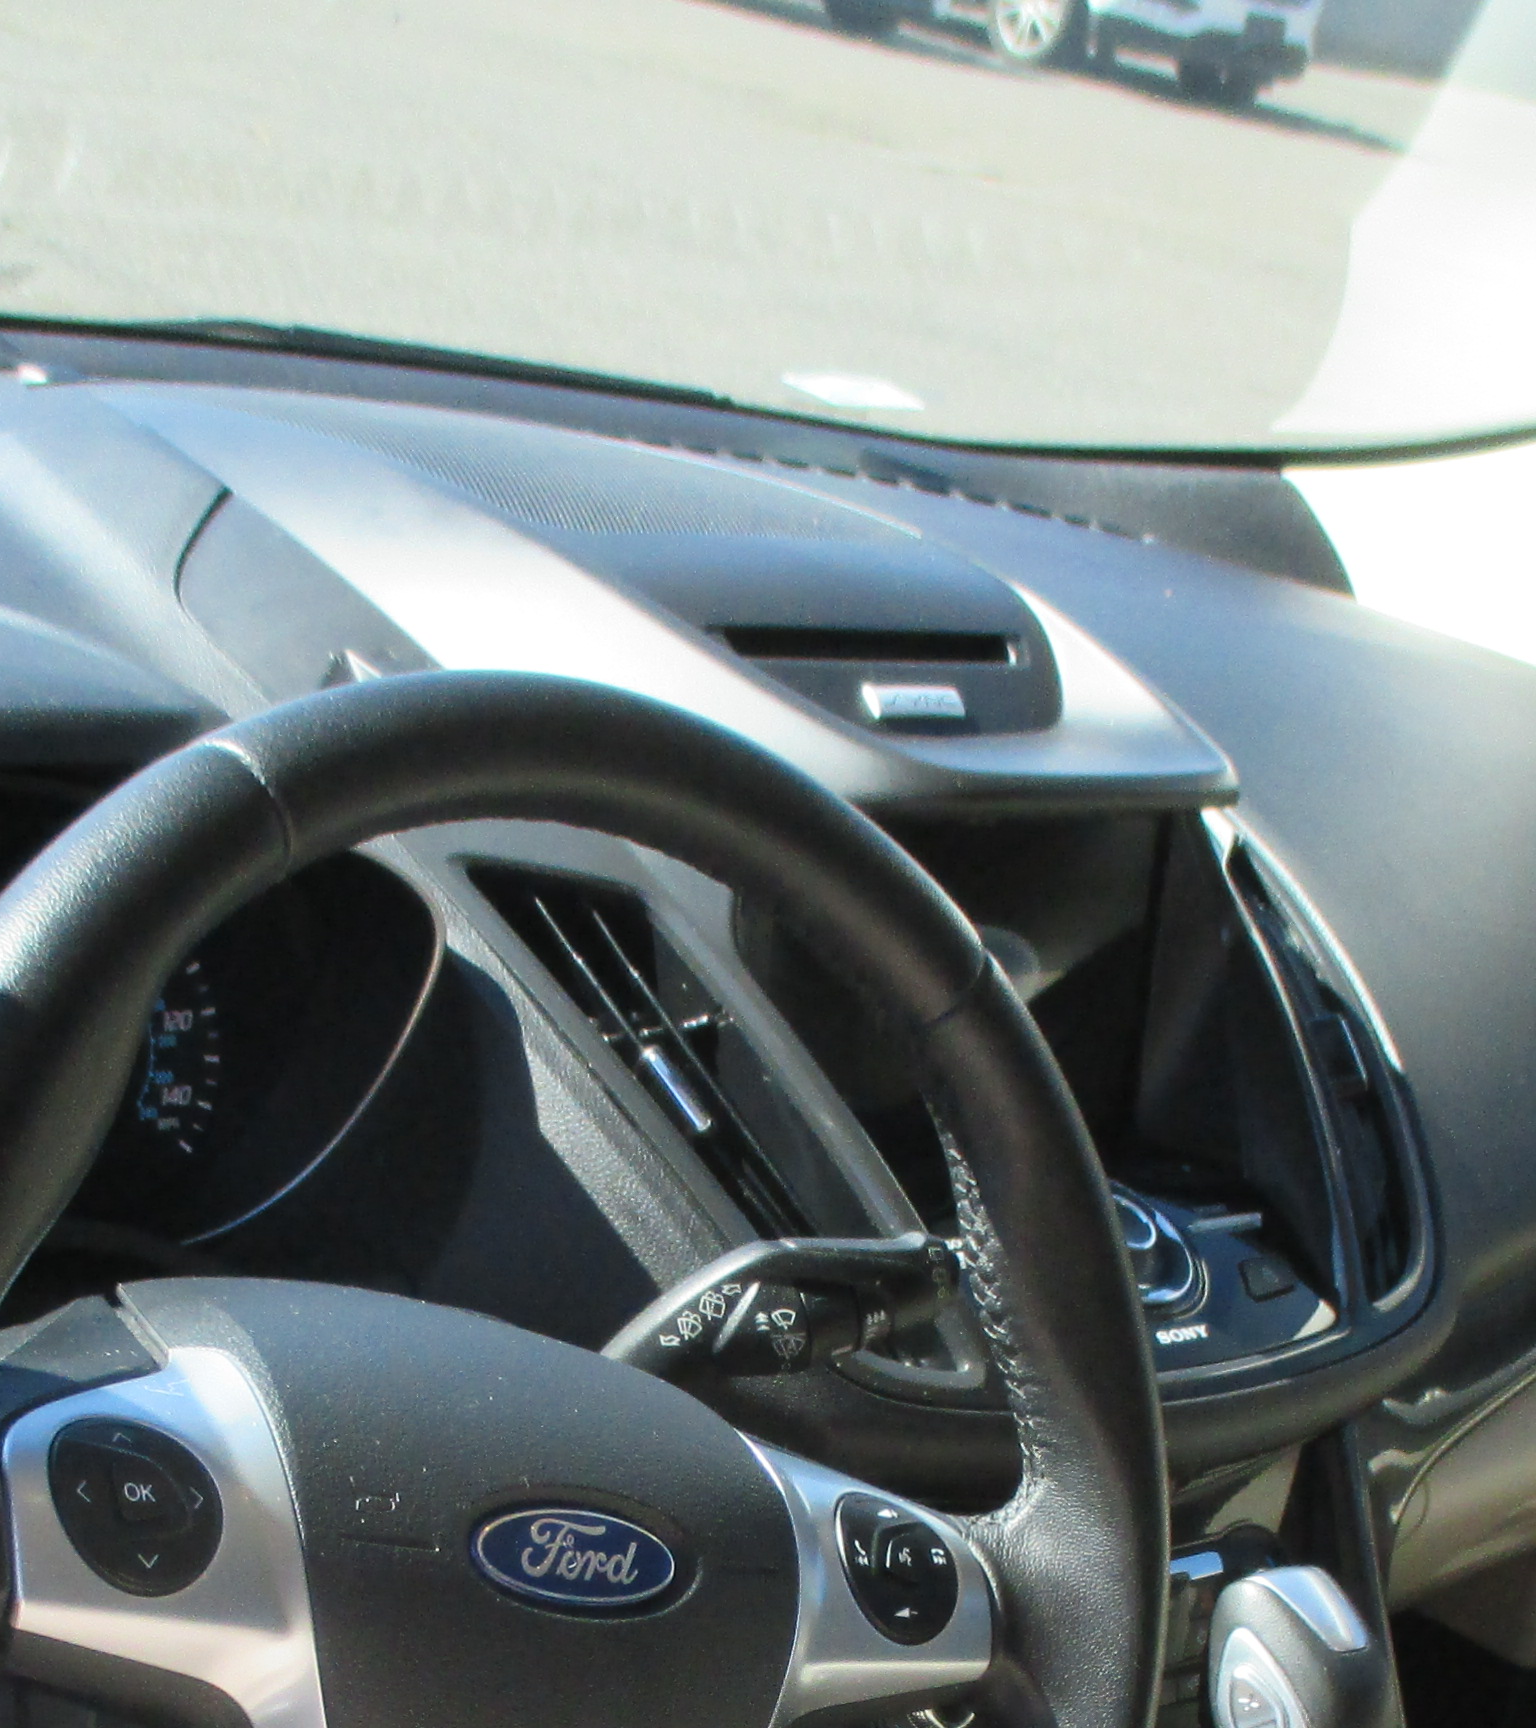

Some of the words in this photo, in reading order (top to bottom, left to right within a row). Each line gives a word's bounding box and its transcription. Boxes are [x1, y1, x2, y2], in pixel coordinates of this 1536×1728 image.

[1155, 1324, 1209, 1345] SONY
[124, 1482, 156, 1502] OK
[521, 1517, 639, 1585] Ford
